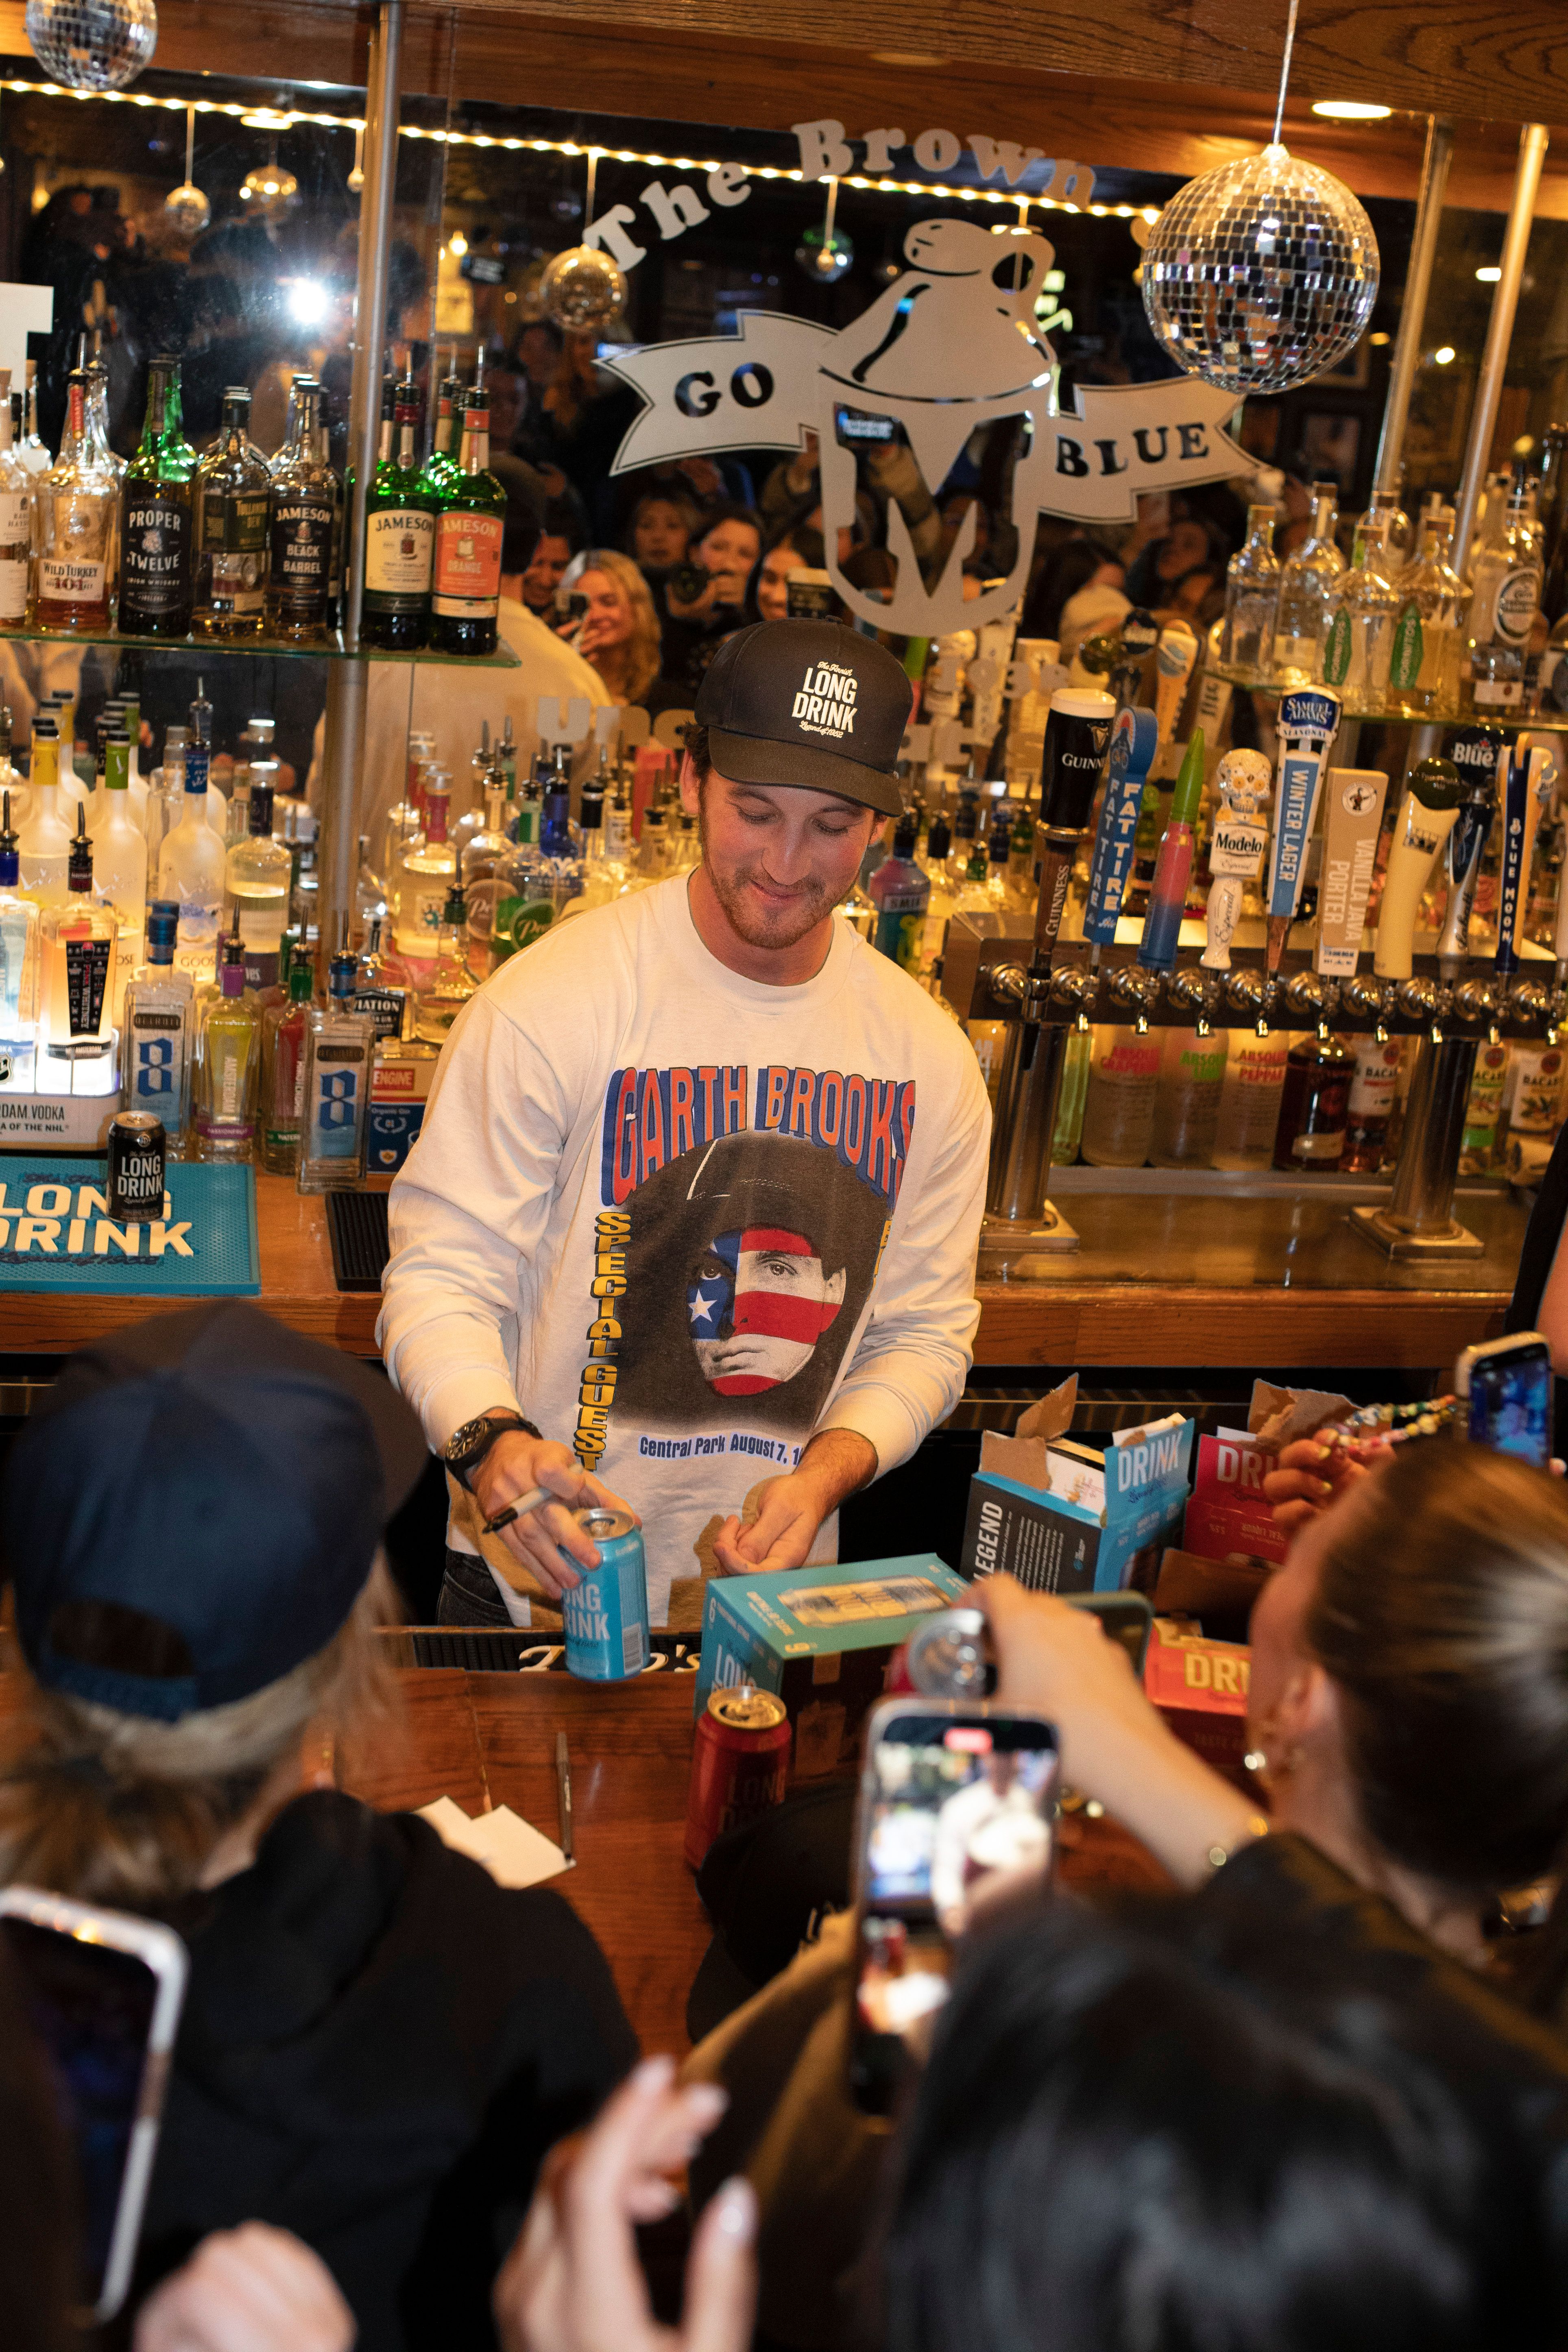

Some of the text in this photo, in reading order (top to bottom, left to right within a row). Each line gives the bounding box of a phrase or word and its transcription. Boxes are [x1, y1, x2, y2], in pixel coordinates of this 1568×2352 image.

[582, 119, 1095, 272] The Brown
[674, 362, 774, 418] GO
[1056, 423, 1209, 477] BLUE
[129, 510, 181, 532] PROPER
[276, 507, 332, 524] JAMESON
[376, 516, 434, 533] JAMESON
[439, 518, 497, 538] JAMESON
[129, 551, 181, 571] TWELVE
[286, 544, 320, 557] BLACK
[44, 562, 98, 578] WILD TURKEY
[283, 560, 322, 574] BARREL
[817, 661, 830, 670] The
[803, 667, 858, 704] LONG
[792, 692, 858, 733] DRINK
[1287, 697, 1332, 717] SAMUEL
[1288, 709, 1328, 725] ADAMS
[1453, 741, 1494, 768] Blue
[1278, 768, 1309, 883] WINTER LAGER
[1103, 783, 1141, 911] FAT TIRE
[1216, 833, 1262, 853] Modelo
[1045, 865, 1070, 936] GUINNESS
[1323, 860, 1351, 924] PORTER
[1501, 887, 1516, 941] MOON
[355, 999, 400, 1012] IATION
[31, 1104, 65, 1120] VODKA
[602, 1066, 748, 1206] GARTH
[122, 1155, 161, 1177] LONG
[118, 1173, 163, 1197] DRINK
[0, 1183, 172, 1220] LON
[573, 1211, 632, 1472] SPECIAL GUEST
[639, 1436, 692, 1458] Central
[694, 1434, 726, 1456] Park
[730, 1433, 775, 1459] August
[1119, 1430, 1183, 1493] DRINK
[566, 1609, 610, 1641] INK
[1184, 1651, 1251, 1695] DRI
